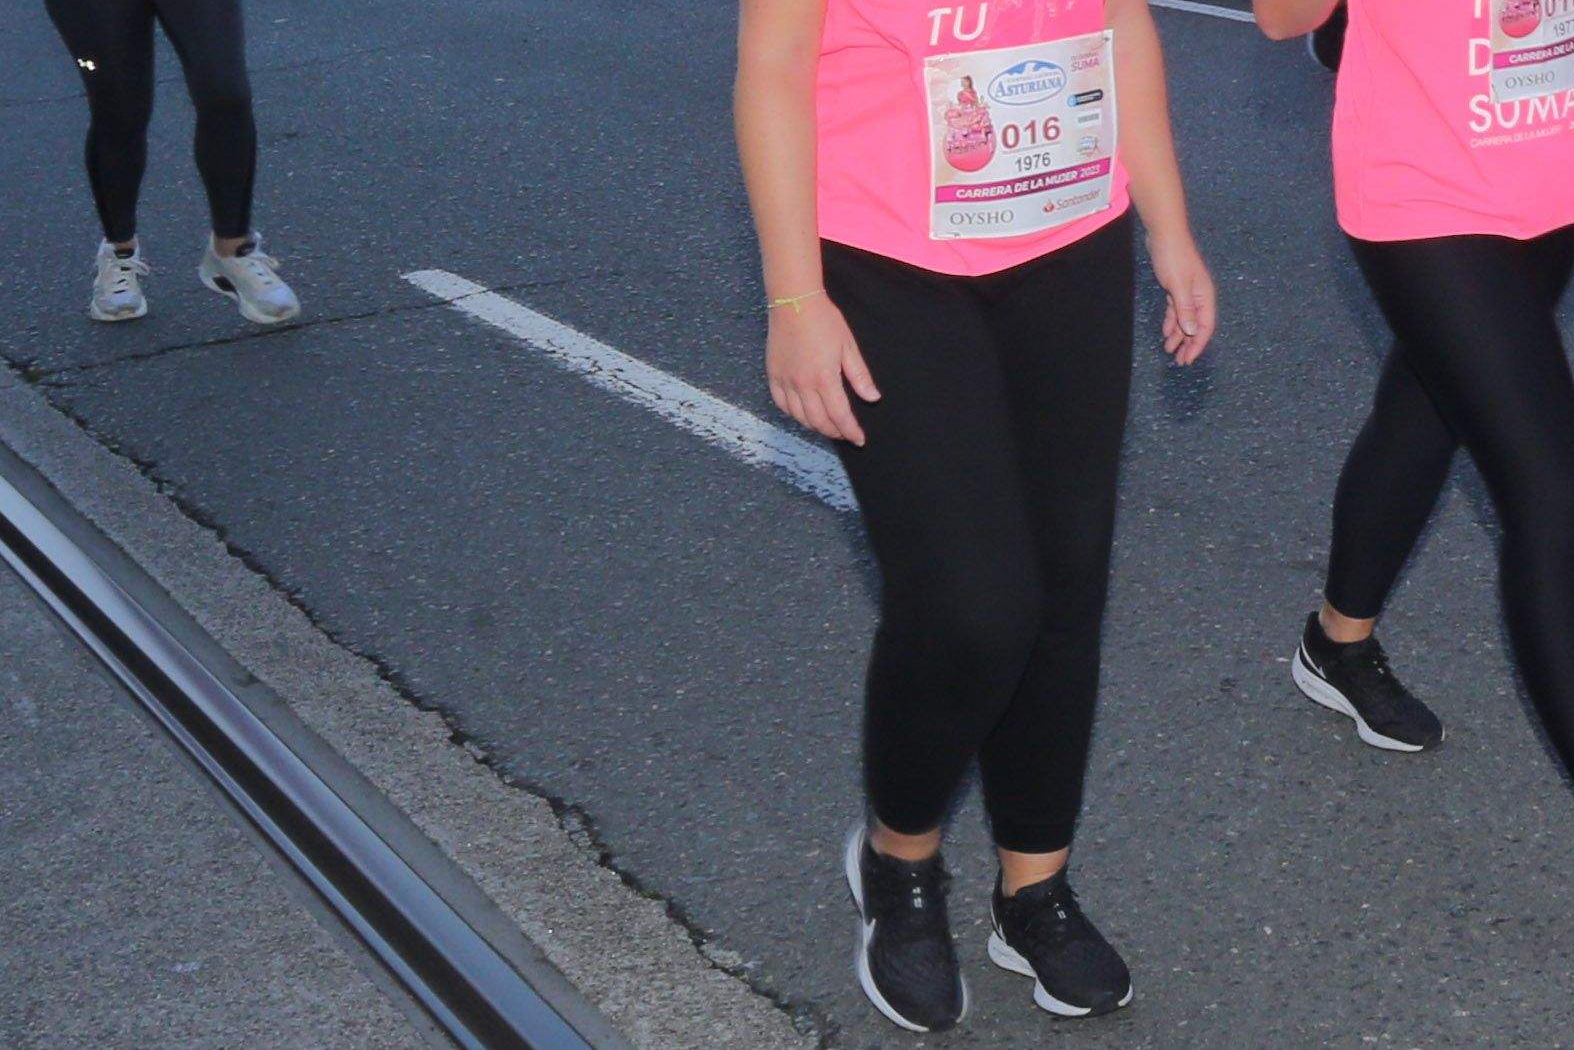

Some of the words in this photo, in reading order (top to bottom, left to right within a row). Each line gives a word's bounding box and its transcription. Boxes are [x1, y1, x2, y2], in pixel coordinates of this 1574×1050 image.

[927, 2, 989, 46] TU
[994, 75, 1063, 99] ASTURIANA
[1504, 70, 1556, 90] OYSHO
[1001, 116, 1061, 150] 016
[1014, 152, 1051, 173] 1976
[955, 184, 1013, 199] CARRERA
[1014, 181, 1030, 193] DE
[1030, 179, 1045, 190] LA
[1056, 189, 1102, 211] Santander
[949, 209, 1015, 226] OYSHO
